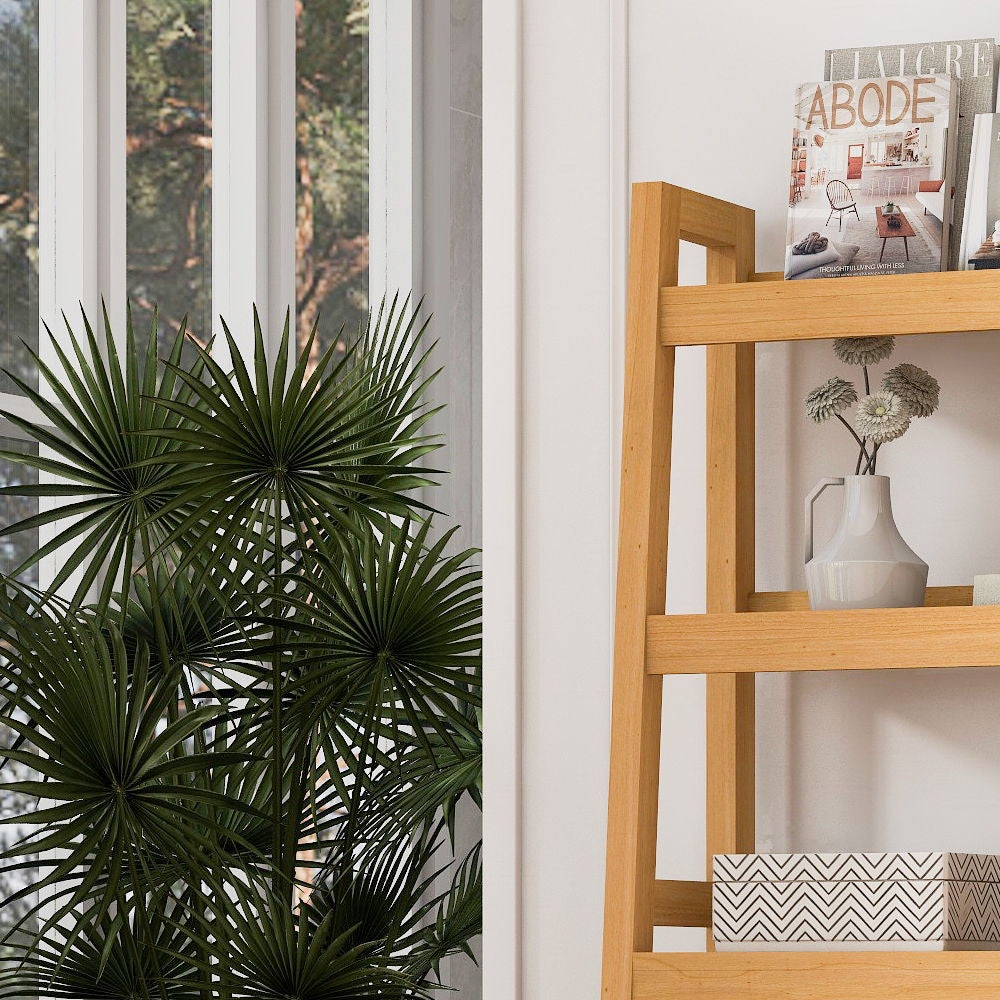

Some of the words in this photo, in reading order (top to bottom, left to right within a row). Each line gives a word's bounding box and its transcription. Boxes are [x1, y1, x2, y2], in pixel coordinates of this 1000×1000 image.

[805, 78, 936, 130] ABODE
[820, 265, 856, 273] THOUGHTFUL
[857, 263, 876, 271] LIVING
